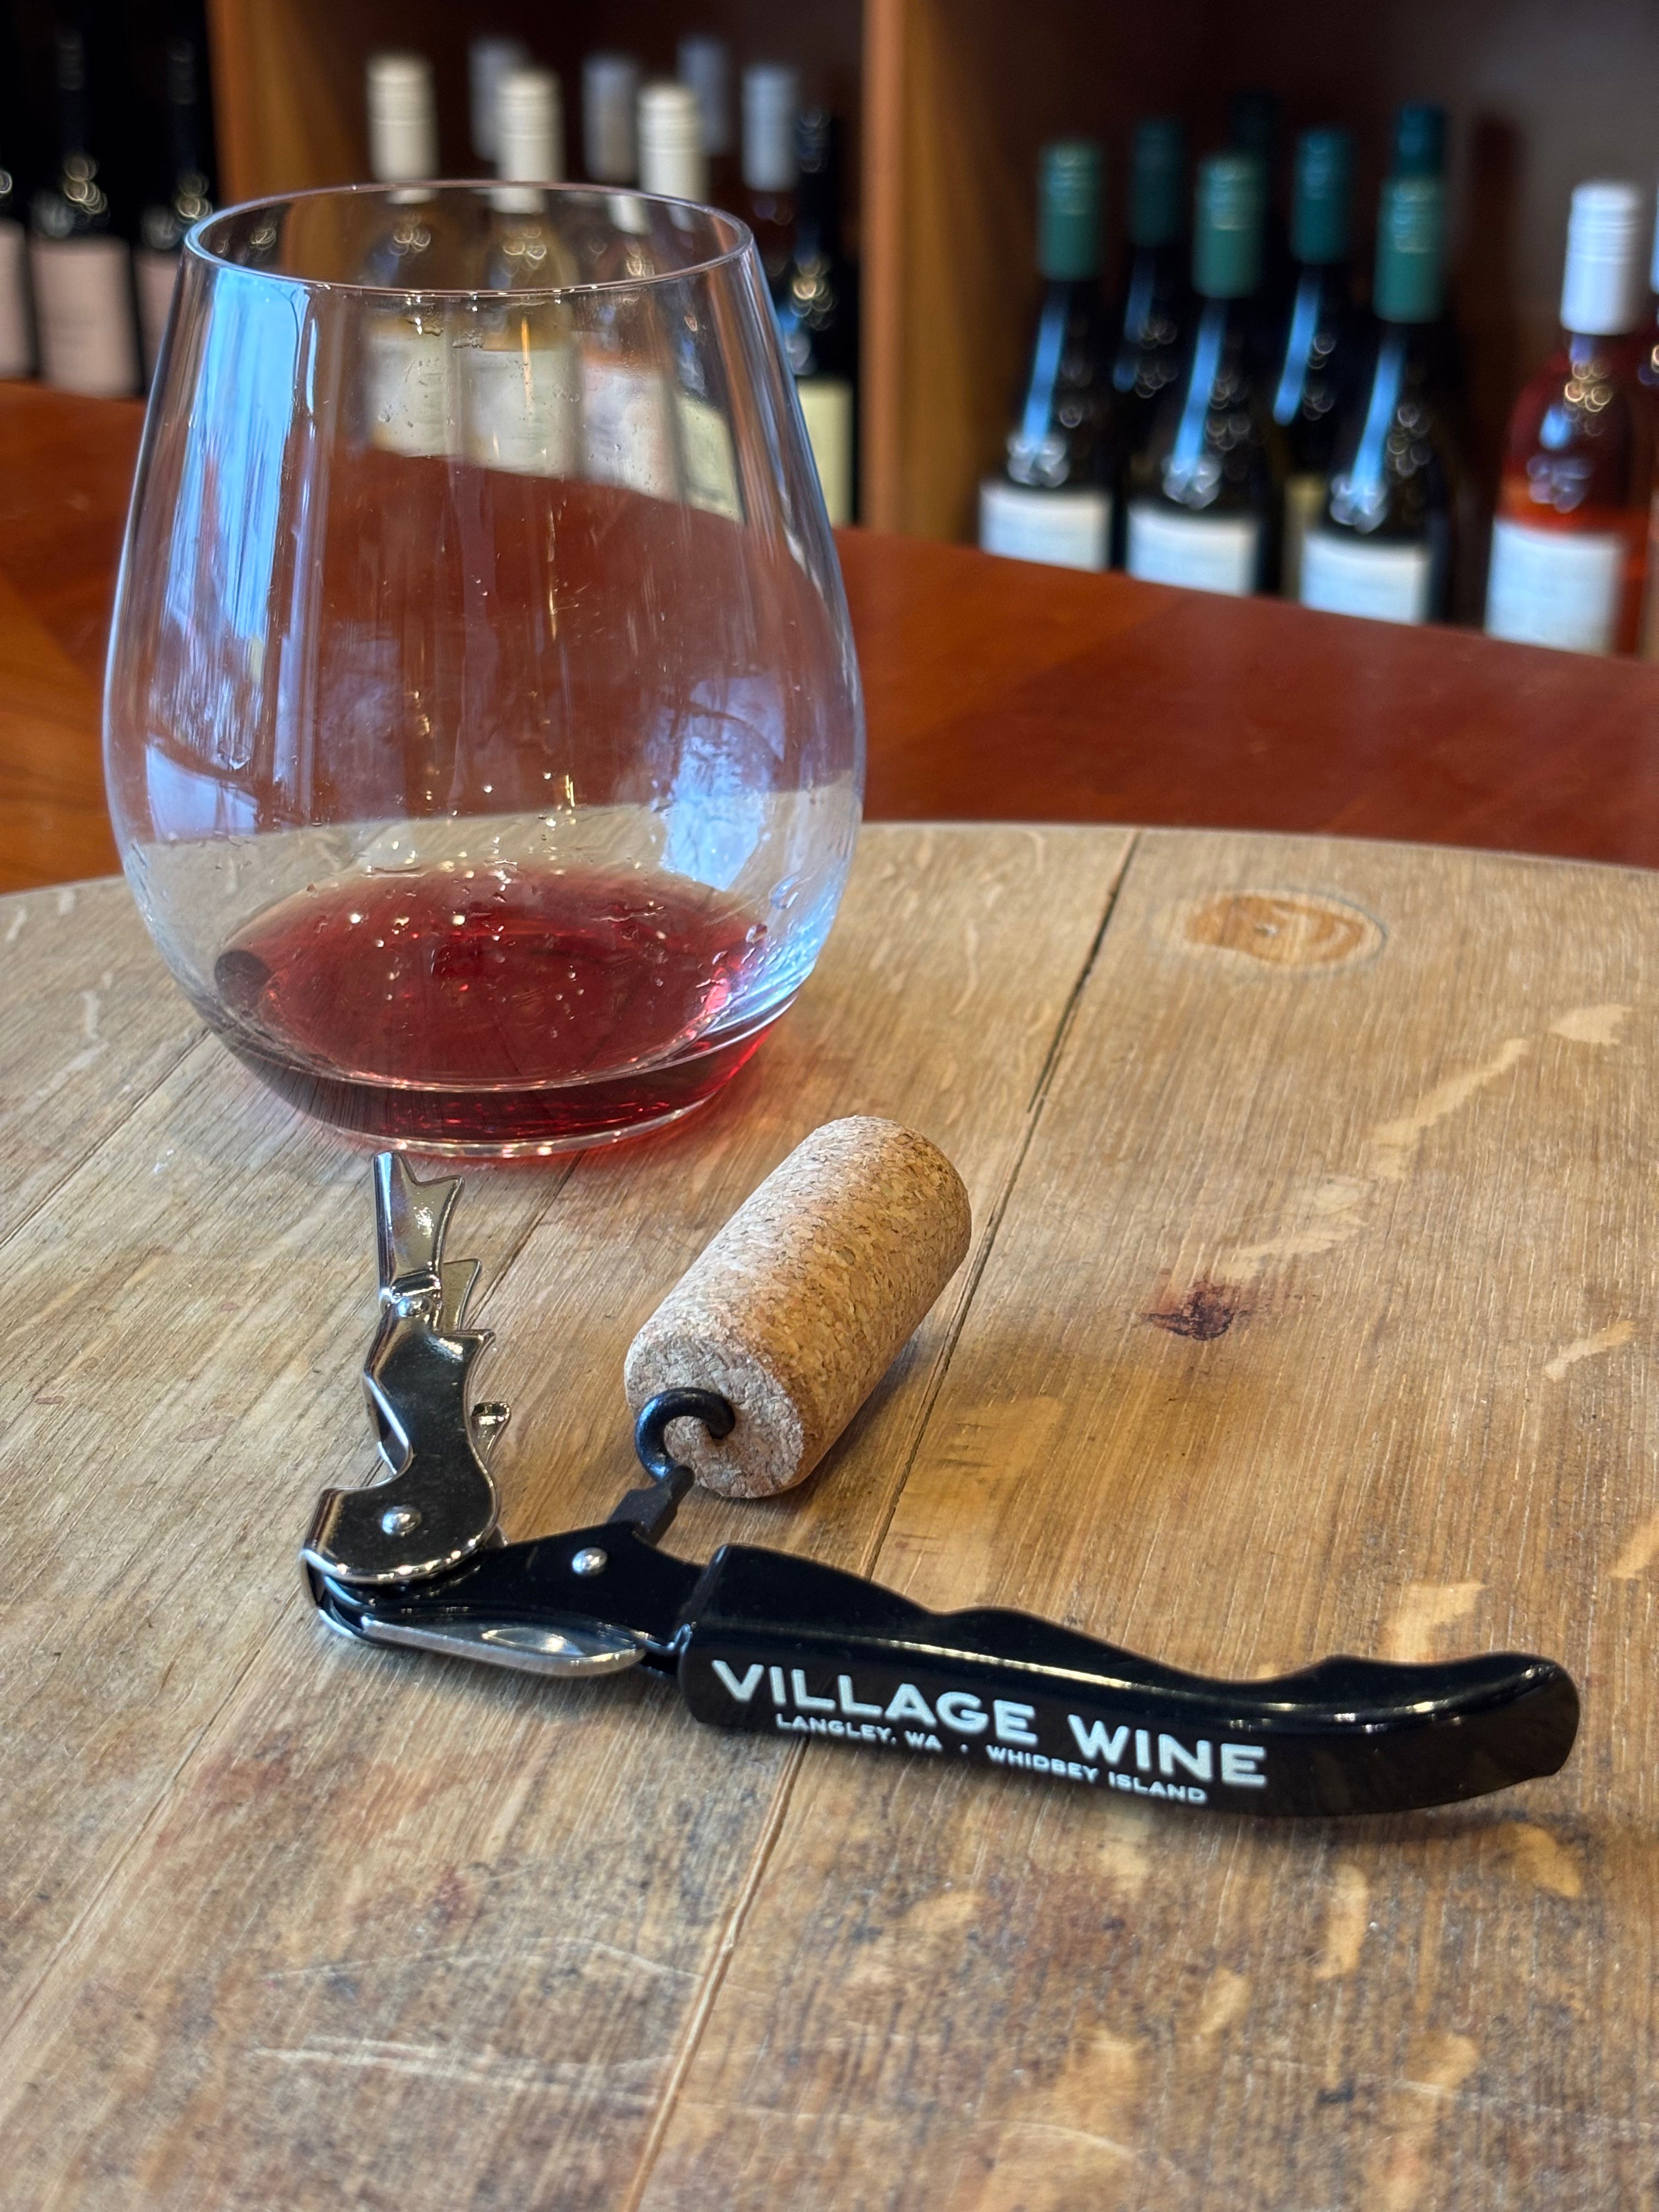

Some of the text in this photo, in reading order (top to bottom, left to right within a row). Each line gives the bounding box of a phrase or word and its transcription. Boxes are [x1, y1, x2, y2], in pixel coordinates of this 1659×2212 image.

[711, 1659, 1268, 1788] VILLAGE WINE
[904, 1730, 943, 1752] WA
[985, 1744, 1099, 1784] WHIDBEY
[1108, 1770, 1208, 1805] ISLAND
